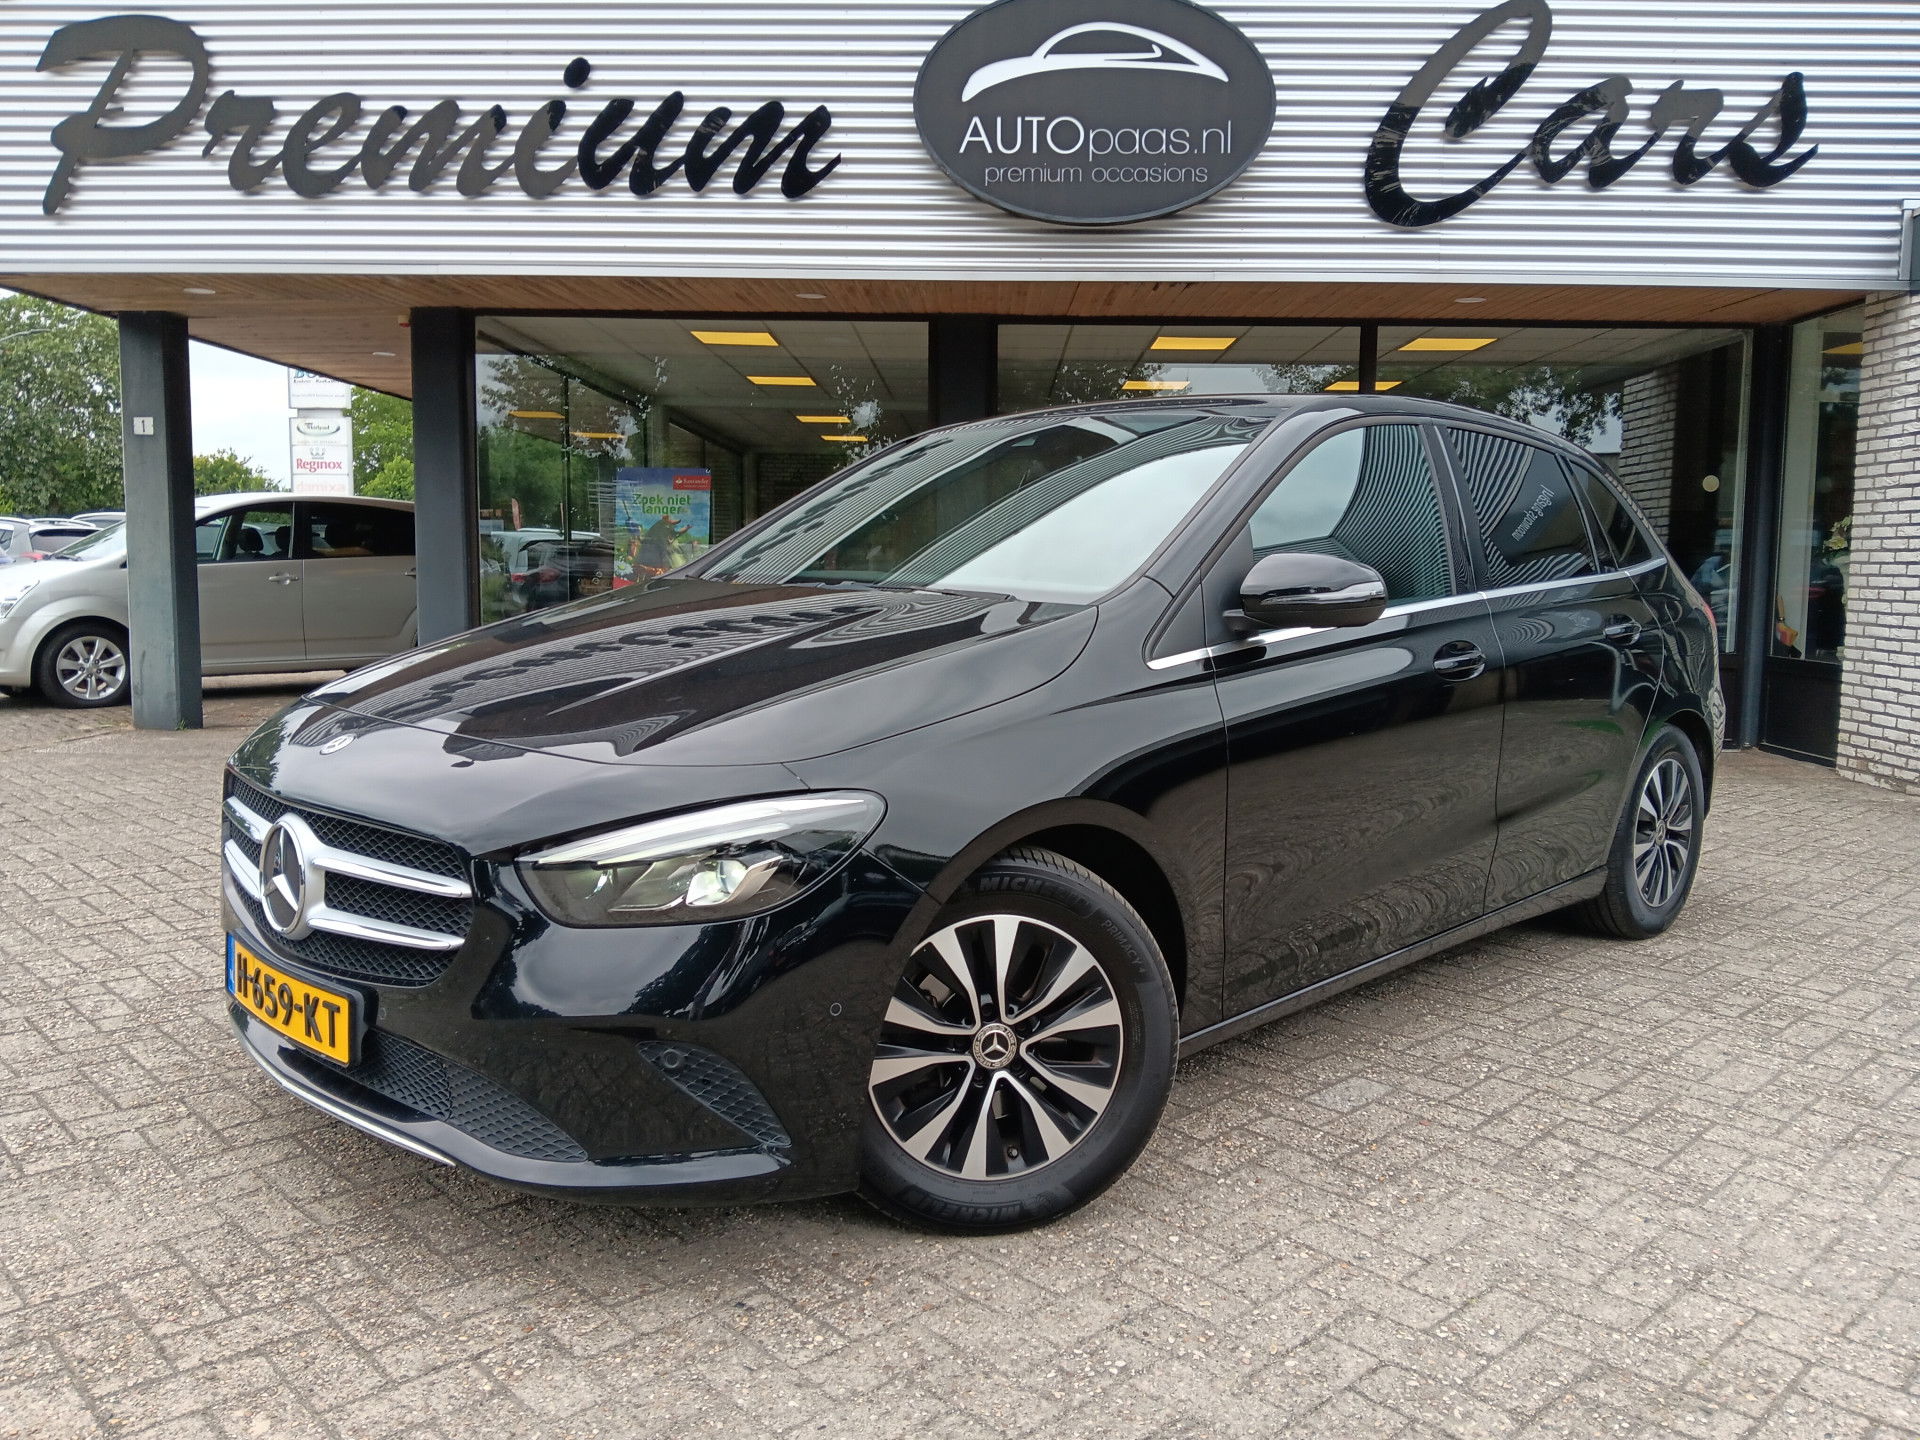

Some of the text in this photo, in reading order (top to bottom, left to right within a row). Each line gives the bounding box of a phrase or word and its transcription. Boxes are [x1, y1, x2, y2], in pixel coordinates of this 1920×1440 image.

[35, 0, 1819, 227] Premium Cars
[958, 116, 1232, 162] AUTOpaas.nl
[984, 163, 1208, 186] premium occasions
[296, 458, 342, 473] Reginox
[632, 493, 691, 506] Zoek niet
[237, 952, 341, 1049] H-659-KT
